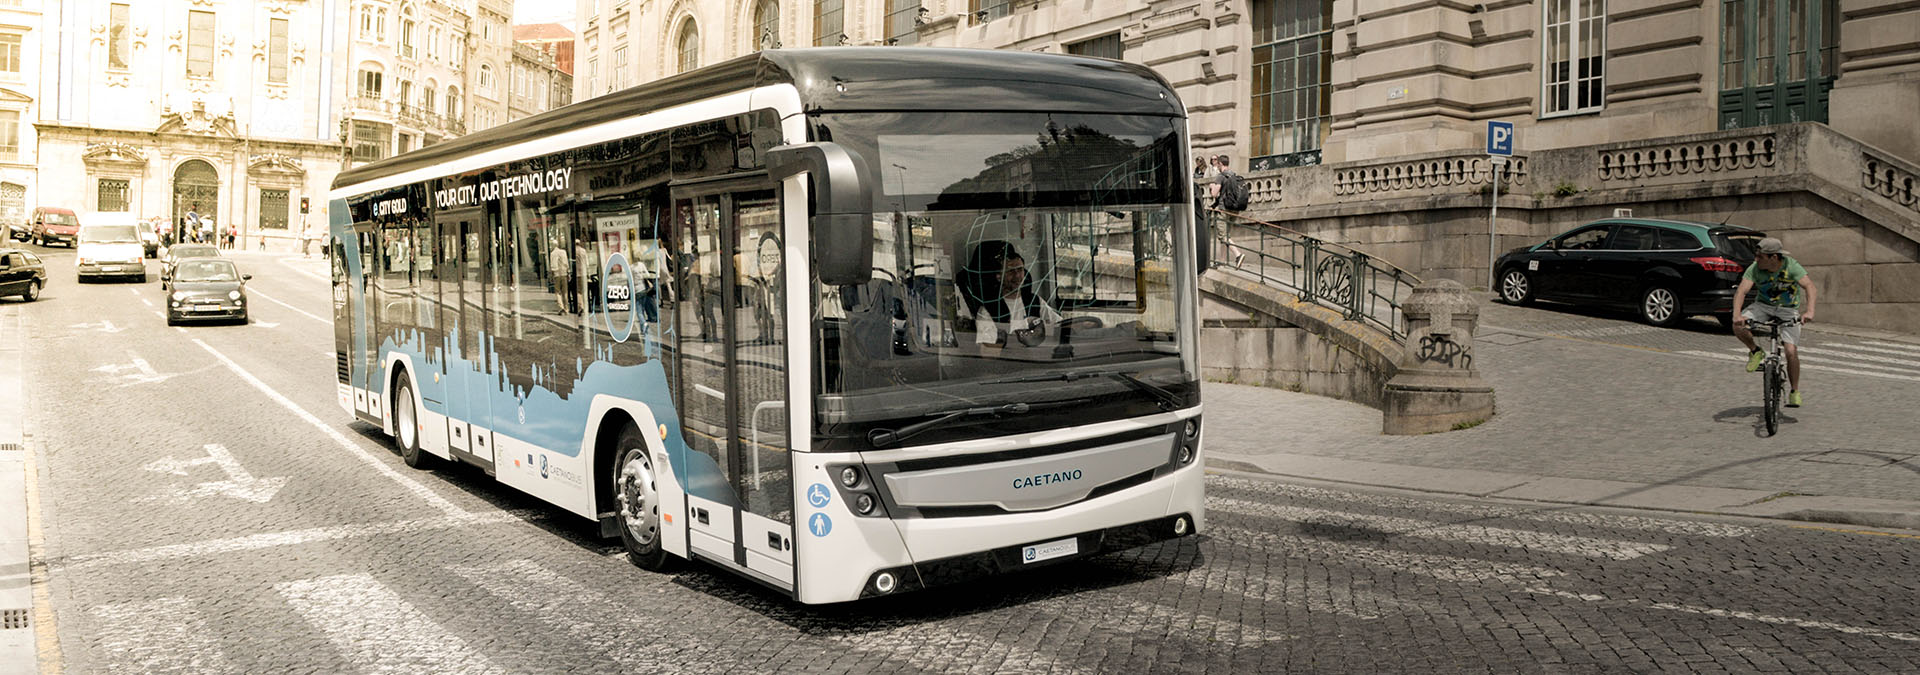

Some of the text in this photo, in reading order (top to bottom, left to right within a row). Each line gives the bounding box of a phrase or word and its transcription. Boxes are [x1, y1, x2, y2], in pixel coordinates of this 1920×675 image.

[1493, 126, 1508, 150] P
[434, 187, 457, 208] YOUR
[458, 184, 478, 206] CITY,
[480, 181, 500, 202] OUR
[501, 166, 572, 198] TECHNOLOGY
[379, 200, 391, 216] CITY
[391, 197, 407, 214] GOLD
[607, 285, 630, 300] ZERO
[1013, 469, 1082, 489] CAETANO
